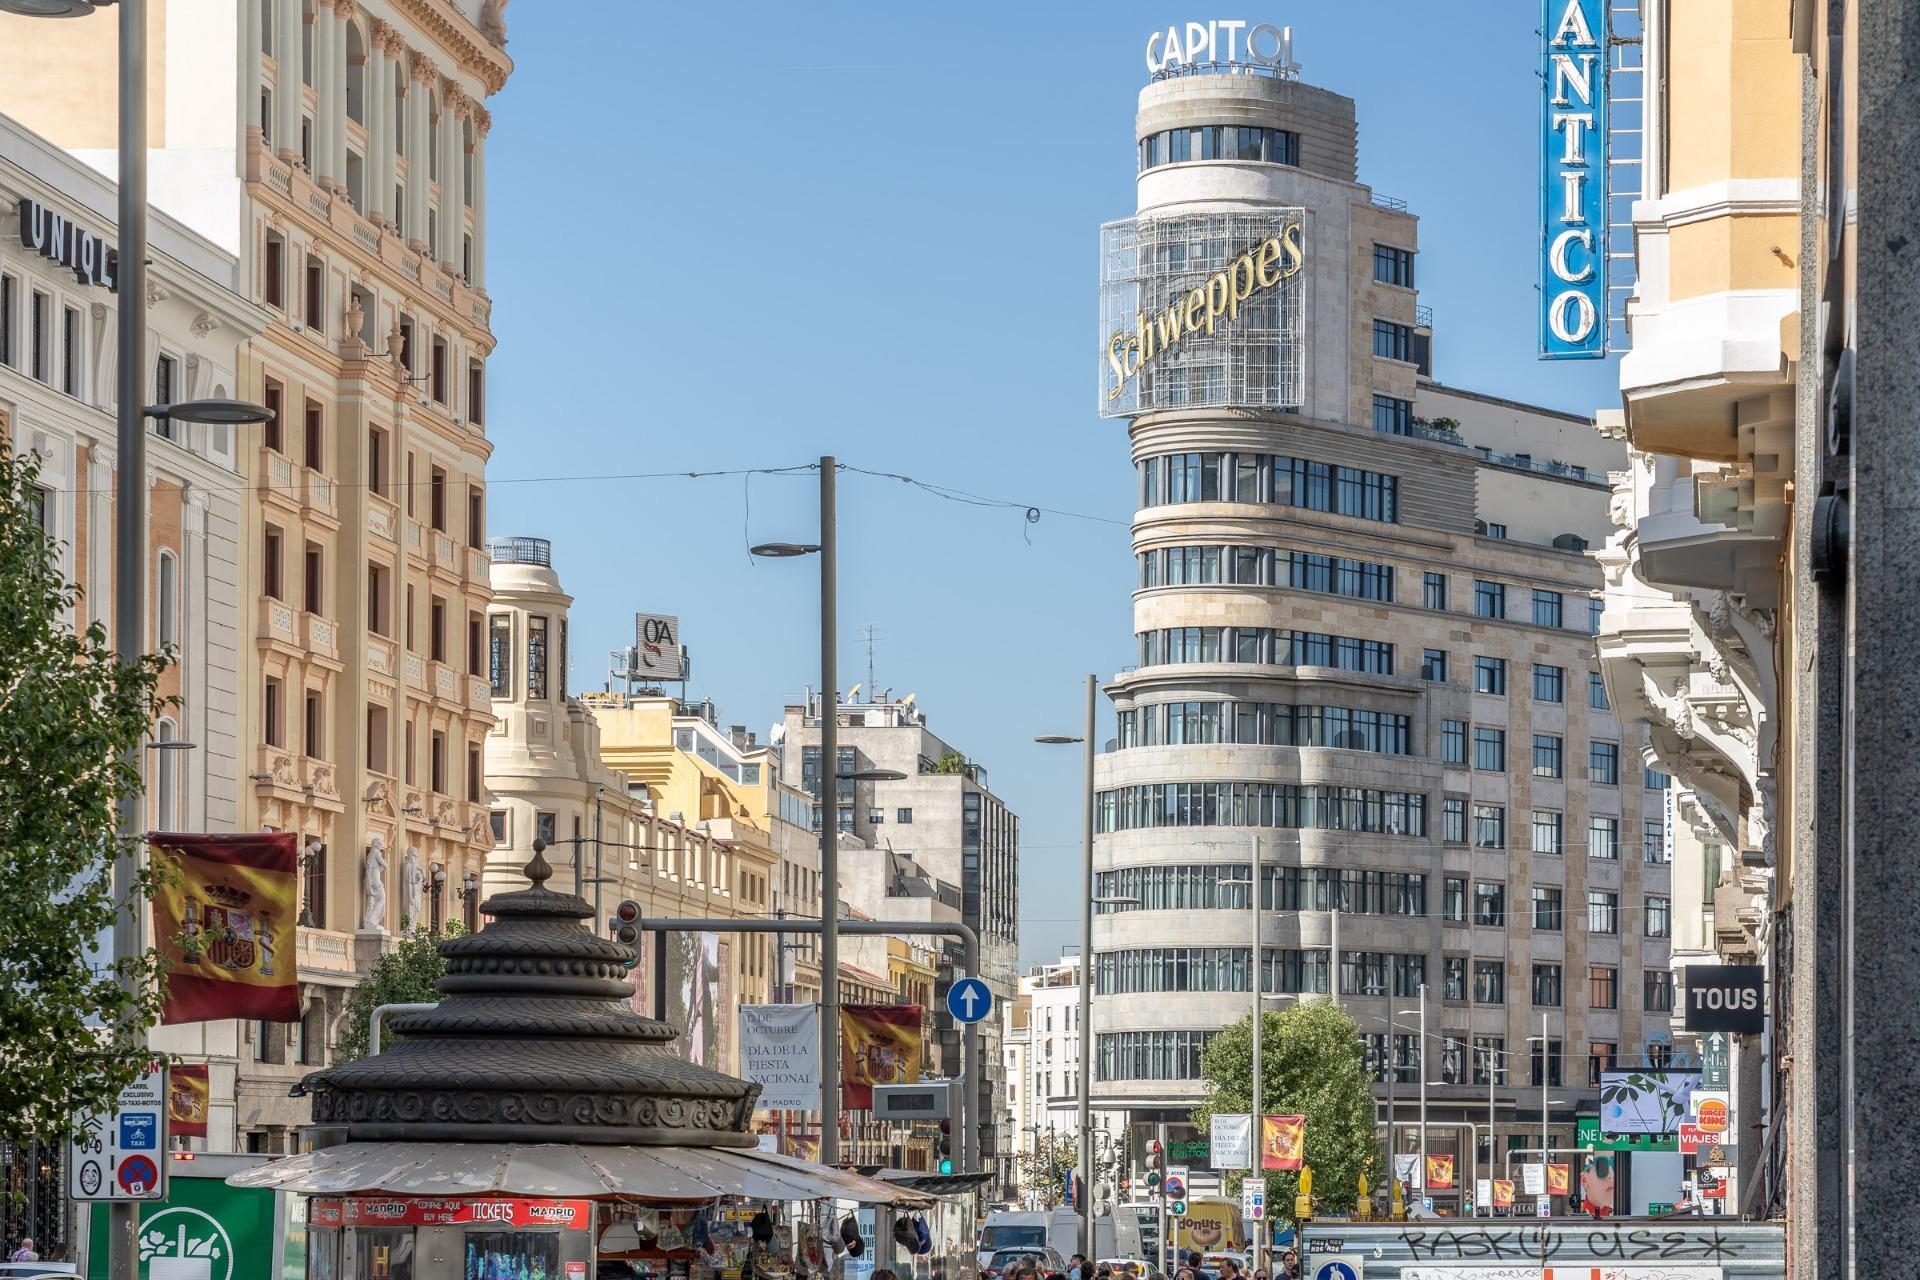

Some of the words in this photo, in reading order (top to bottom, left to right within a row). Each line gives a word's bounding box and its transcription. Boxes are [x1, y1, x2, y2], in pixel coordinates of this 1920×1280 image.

[1146, 19, 1303, 74] CAPITOL
[1549, 0, 1597, 344] ANTICO
[22, 200, 116, 290] UNIQL
[1107, 219, 1303, 401] Schweppes
[1691, 987, 1758, 1010] TOUS
[747, 1025, 799, 1034] OCTUBRE
[772, 1045, 790, 1055] DE
[792, 1045, 808, 1055] LA
[749, 1060, 790, 1070] FIESTA
[749, 1073, 814, 1084] NACIONAL
[1699, 1109, 1726, 1117] BURGER
[1698, 1116, 1726, 1125] KING
[1681, 1134, 1719, 1144] VIAJES
[365, 1204, 406, 1215] MADRID
[418, 1202, 442, 1210] COMPRE
[471, 1202, 514, 1220] TICKETS
[423, 1213, 435, 1221] BUY
[438, 1213, 454, 1221] HERE
[530, 1206, 576, 1218] MADRID
[1179, 1217, 1222, 1231] donuts
